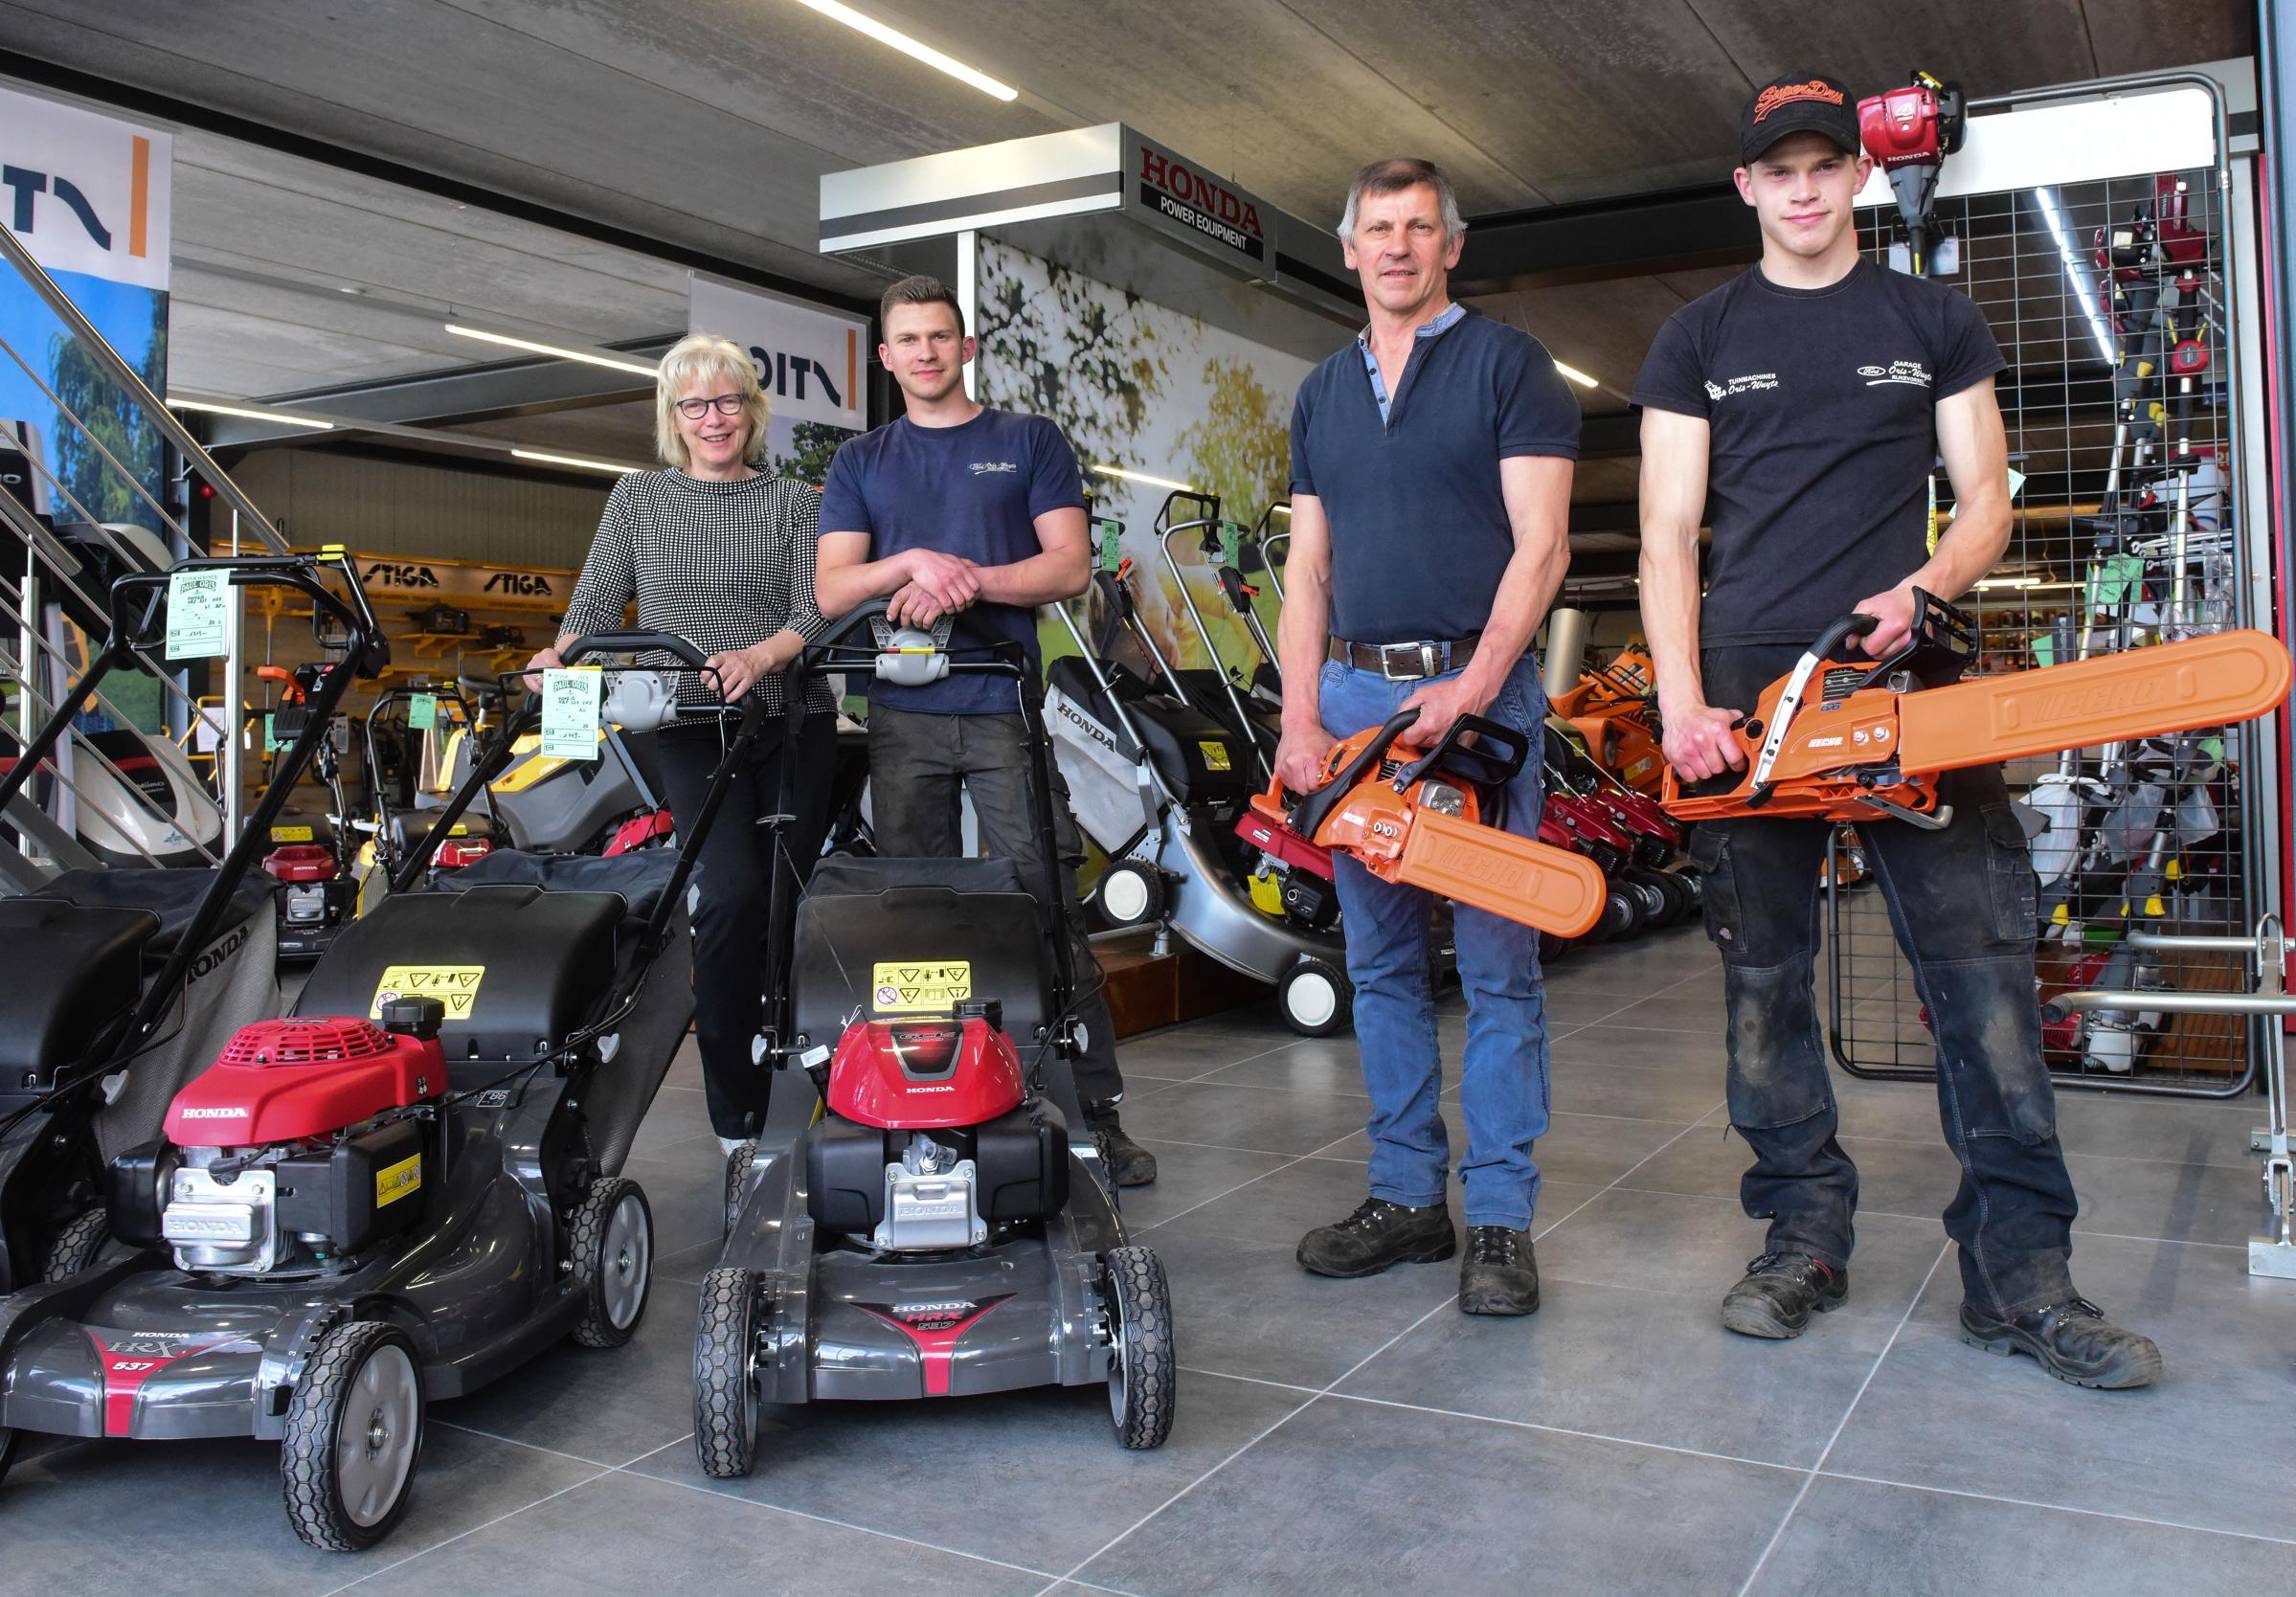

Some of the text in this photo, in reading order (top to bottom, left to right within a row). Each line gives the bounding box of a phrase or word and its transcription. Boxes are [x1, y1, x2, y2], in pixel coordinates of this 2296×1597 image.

[1886, 151, 1930, 163] HONDA
[1140, 146, 1264, 238] HONDA
[1160, 195, 1247, 250] POWER EQUIPMENT
[1893, 360, 1922, 369] GARAGE
[1727, 372, 1777, 386] TUINMACHINES
[362, 563, 439, 588] STIGA
[181, 580, 216, 593] PAUL ORIS
[484, 574, 552, 596] STIGA
[553, 680, 589, 693] PAUL ORIS
[1057, 702, 1114, 753] HONDA
[182, 1108, 249, 1118] HONDA
[168, 1219, 246, 1233] HONDA
[891, 1301, 979, 1313] HONDA
[906, 1312, 963, 1322] HRX
[106, 1340, 178, 1359] HRX
[112, 1361, 155, 1371] 537
